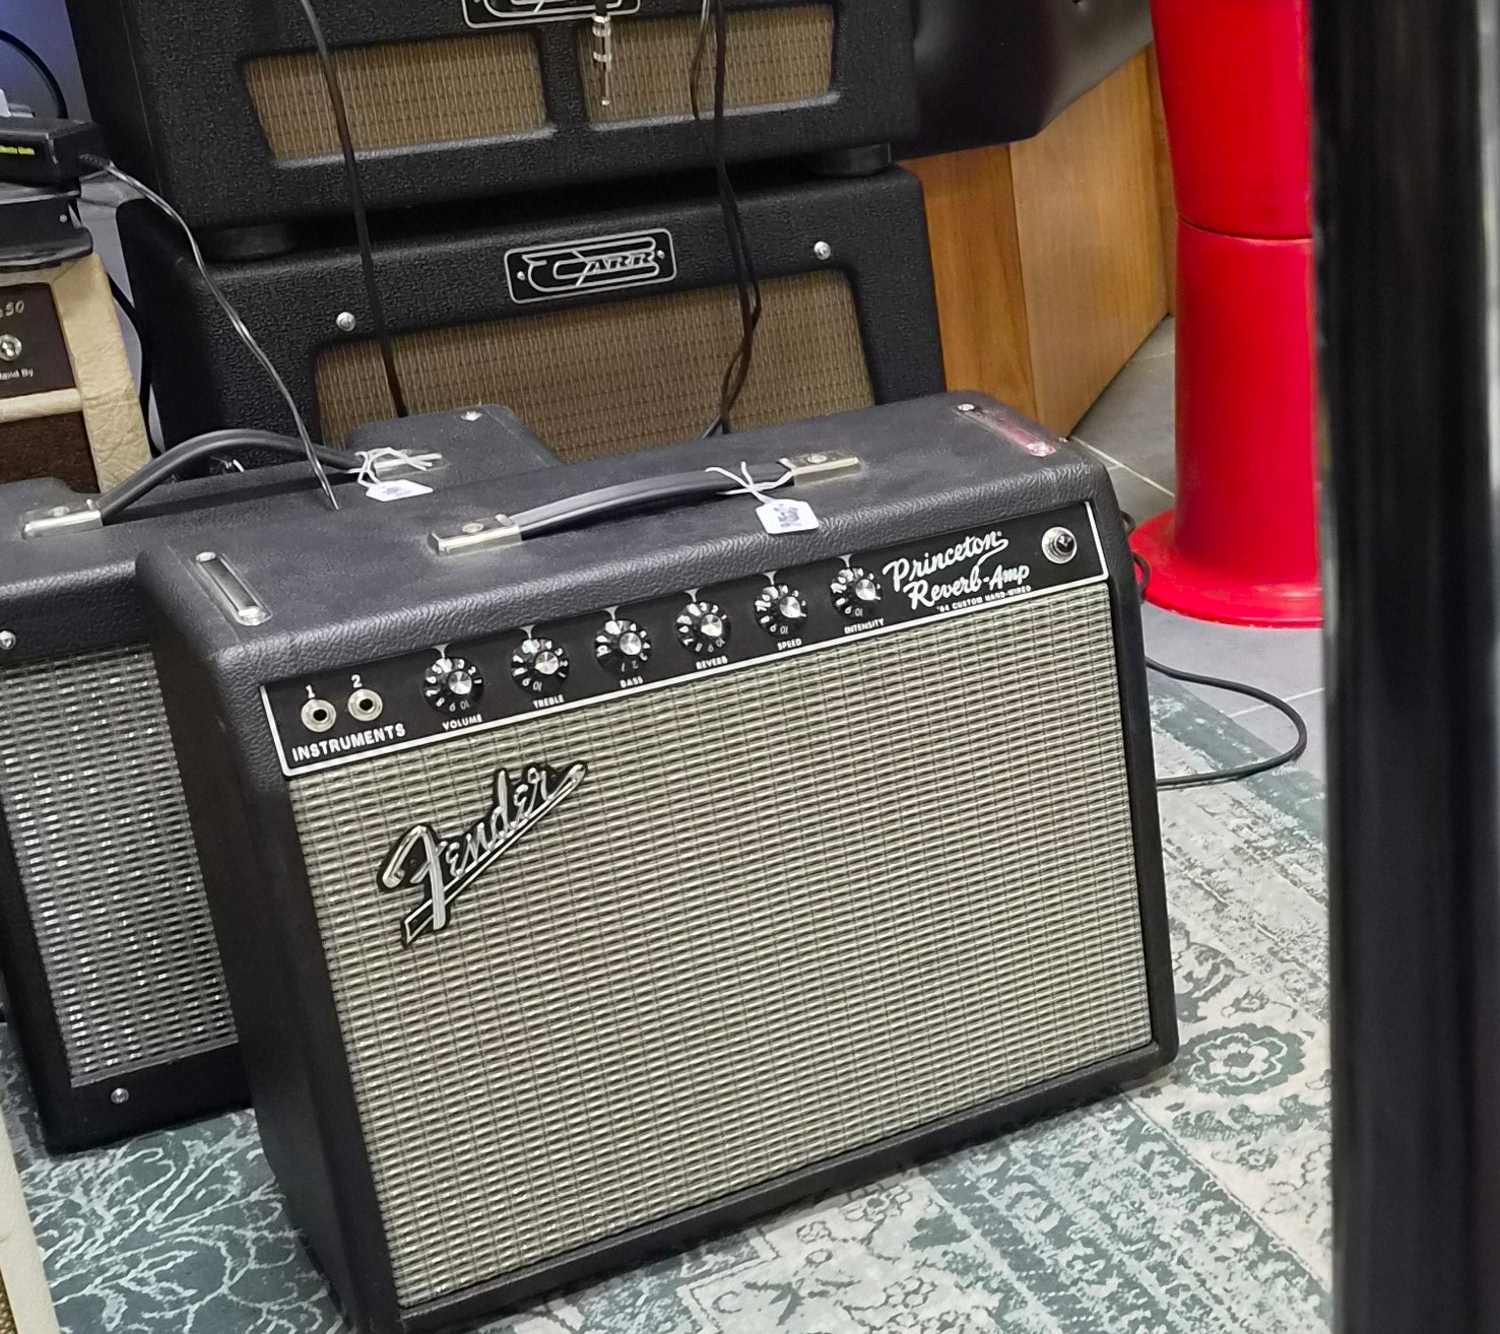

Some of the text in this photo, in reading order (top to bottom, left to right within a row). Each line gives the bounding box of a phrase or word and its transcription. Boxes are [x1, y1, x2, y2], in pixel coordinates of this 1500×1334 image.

[882, 530, 1003, 593] Princeton
[844, 617, 886, 635] INTENSITY
[776, 637, 803, 652] SPEED
[694, 654, 729, 670] REVERB
[350, 673, 363, 688] 2
[618, 675, 645, 689] BASS
[304, 684, 316, 699] 1
[531, 693, 566, 710] TREBLE
[441, 713, 483, 731] VOLUME
[290, 722, 407, 763] INSTRUMENTS
[382, 762, 588, 944] Fender
